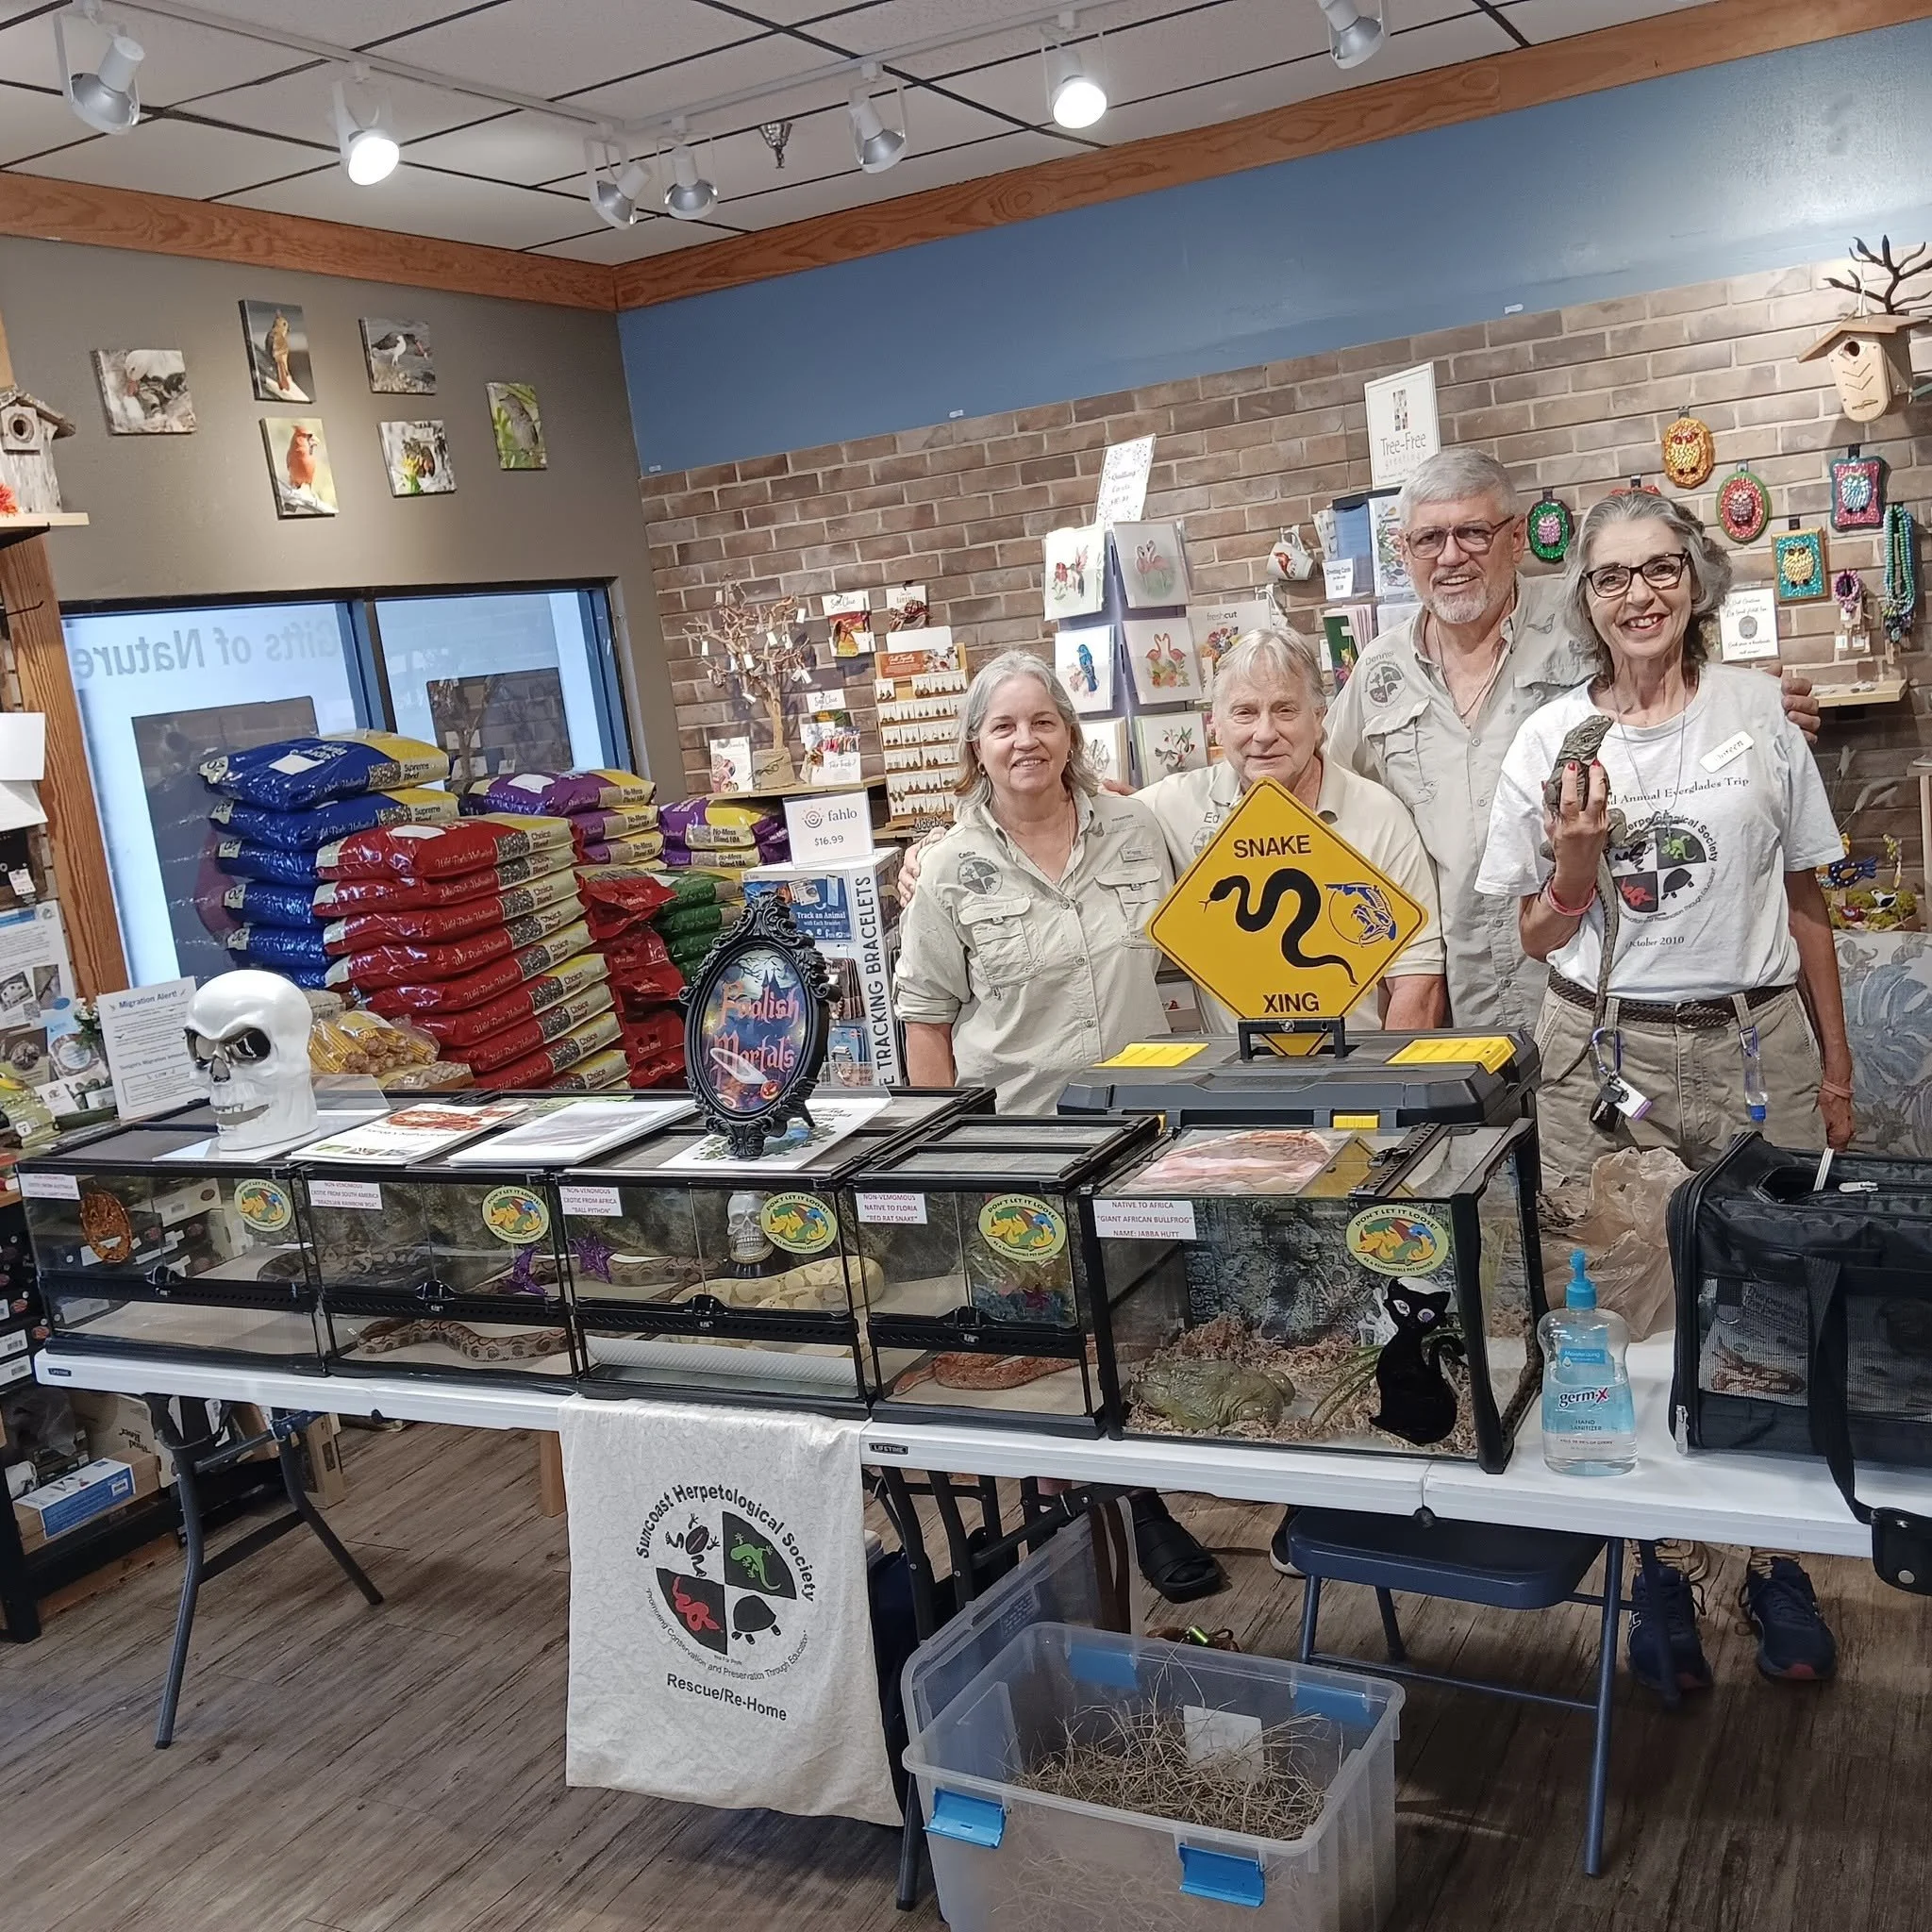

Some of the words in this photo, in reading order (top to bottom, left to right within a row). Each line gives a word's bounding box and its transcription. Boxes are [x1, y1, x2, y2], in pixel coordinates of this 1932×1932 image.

[1380, 431, 1426, 457] Tree-Free
[1365, 650, 1395, 666] Dennis
[1621, 789, 1660, 805] Annual
[1664, 778, 1722, 799] Everglades
[1724, 775, 1750, 788] Trip
[827, 808, 858, 822] fahlo
[1204, 811, 1221, 824] Ed
[814, 834, 844, 846] $16.99
[1233, 834, 1312, 858] SNAKE
[1697, 824, 1719, 862] Society
[797, 911, 814, 920] Track
[824, 910, 846, 919] Animal
[855, 876, 882, 975] BRACELETS
[1660, 936, 1685, 946] 2010
[119, 995, 156, 1009] Migration
[157, 990, 178, 1002] Alert!
[718, 981, 801, 1028] Foolish
[1262, 991, 1320, 1014] XING
[868, 980, 895, 1072] TRACKING
[710, 1030, 796, 1075] Mortals
[987, 1199, 1009, 1213] DON'T
[1096, 1215, 1122, 1224] "GIANT
[1123, 1215, 1153, 1224] AFRICAN
[1153, 1216, 1192, 1224] BULLFROG"
[1355, 1209, 1379, 1227] DON'T
[1408, 1211, 1439, 1230] LOOSE!
[1113, 1229, 1137, 1238] NAME:
[1138, 1229, 1159, 1238] JABBA
[1160, 1230, 1180, 1239] HUTT
[635, 1491, 675, 1559] Suncoast
[672, 1483, 785, 1536] Herpetological
[781, 1531, 817, 1603] Society
[666, 1627, 708, 1668] Conservation
[708, 1661, 723, 1674] and
[666, 1673, 788, 1721] Rescue/Re-Home
